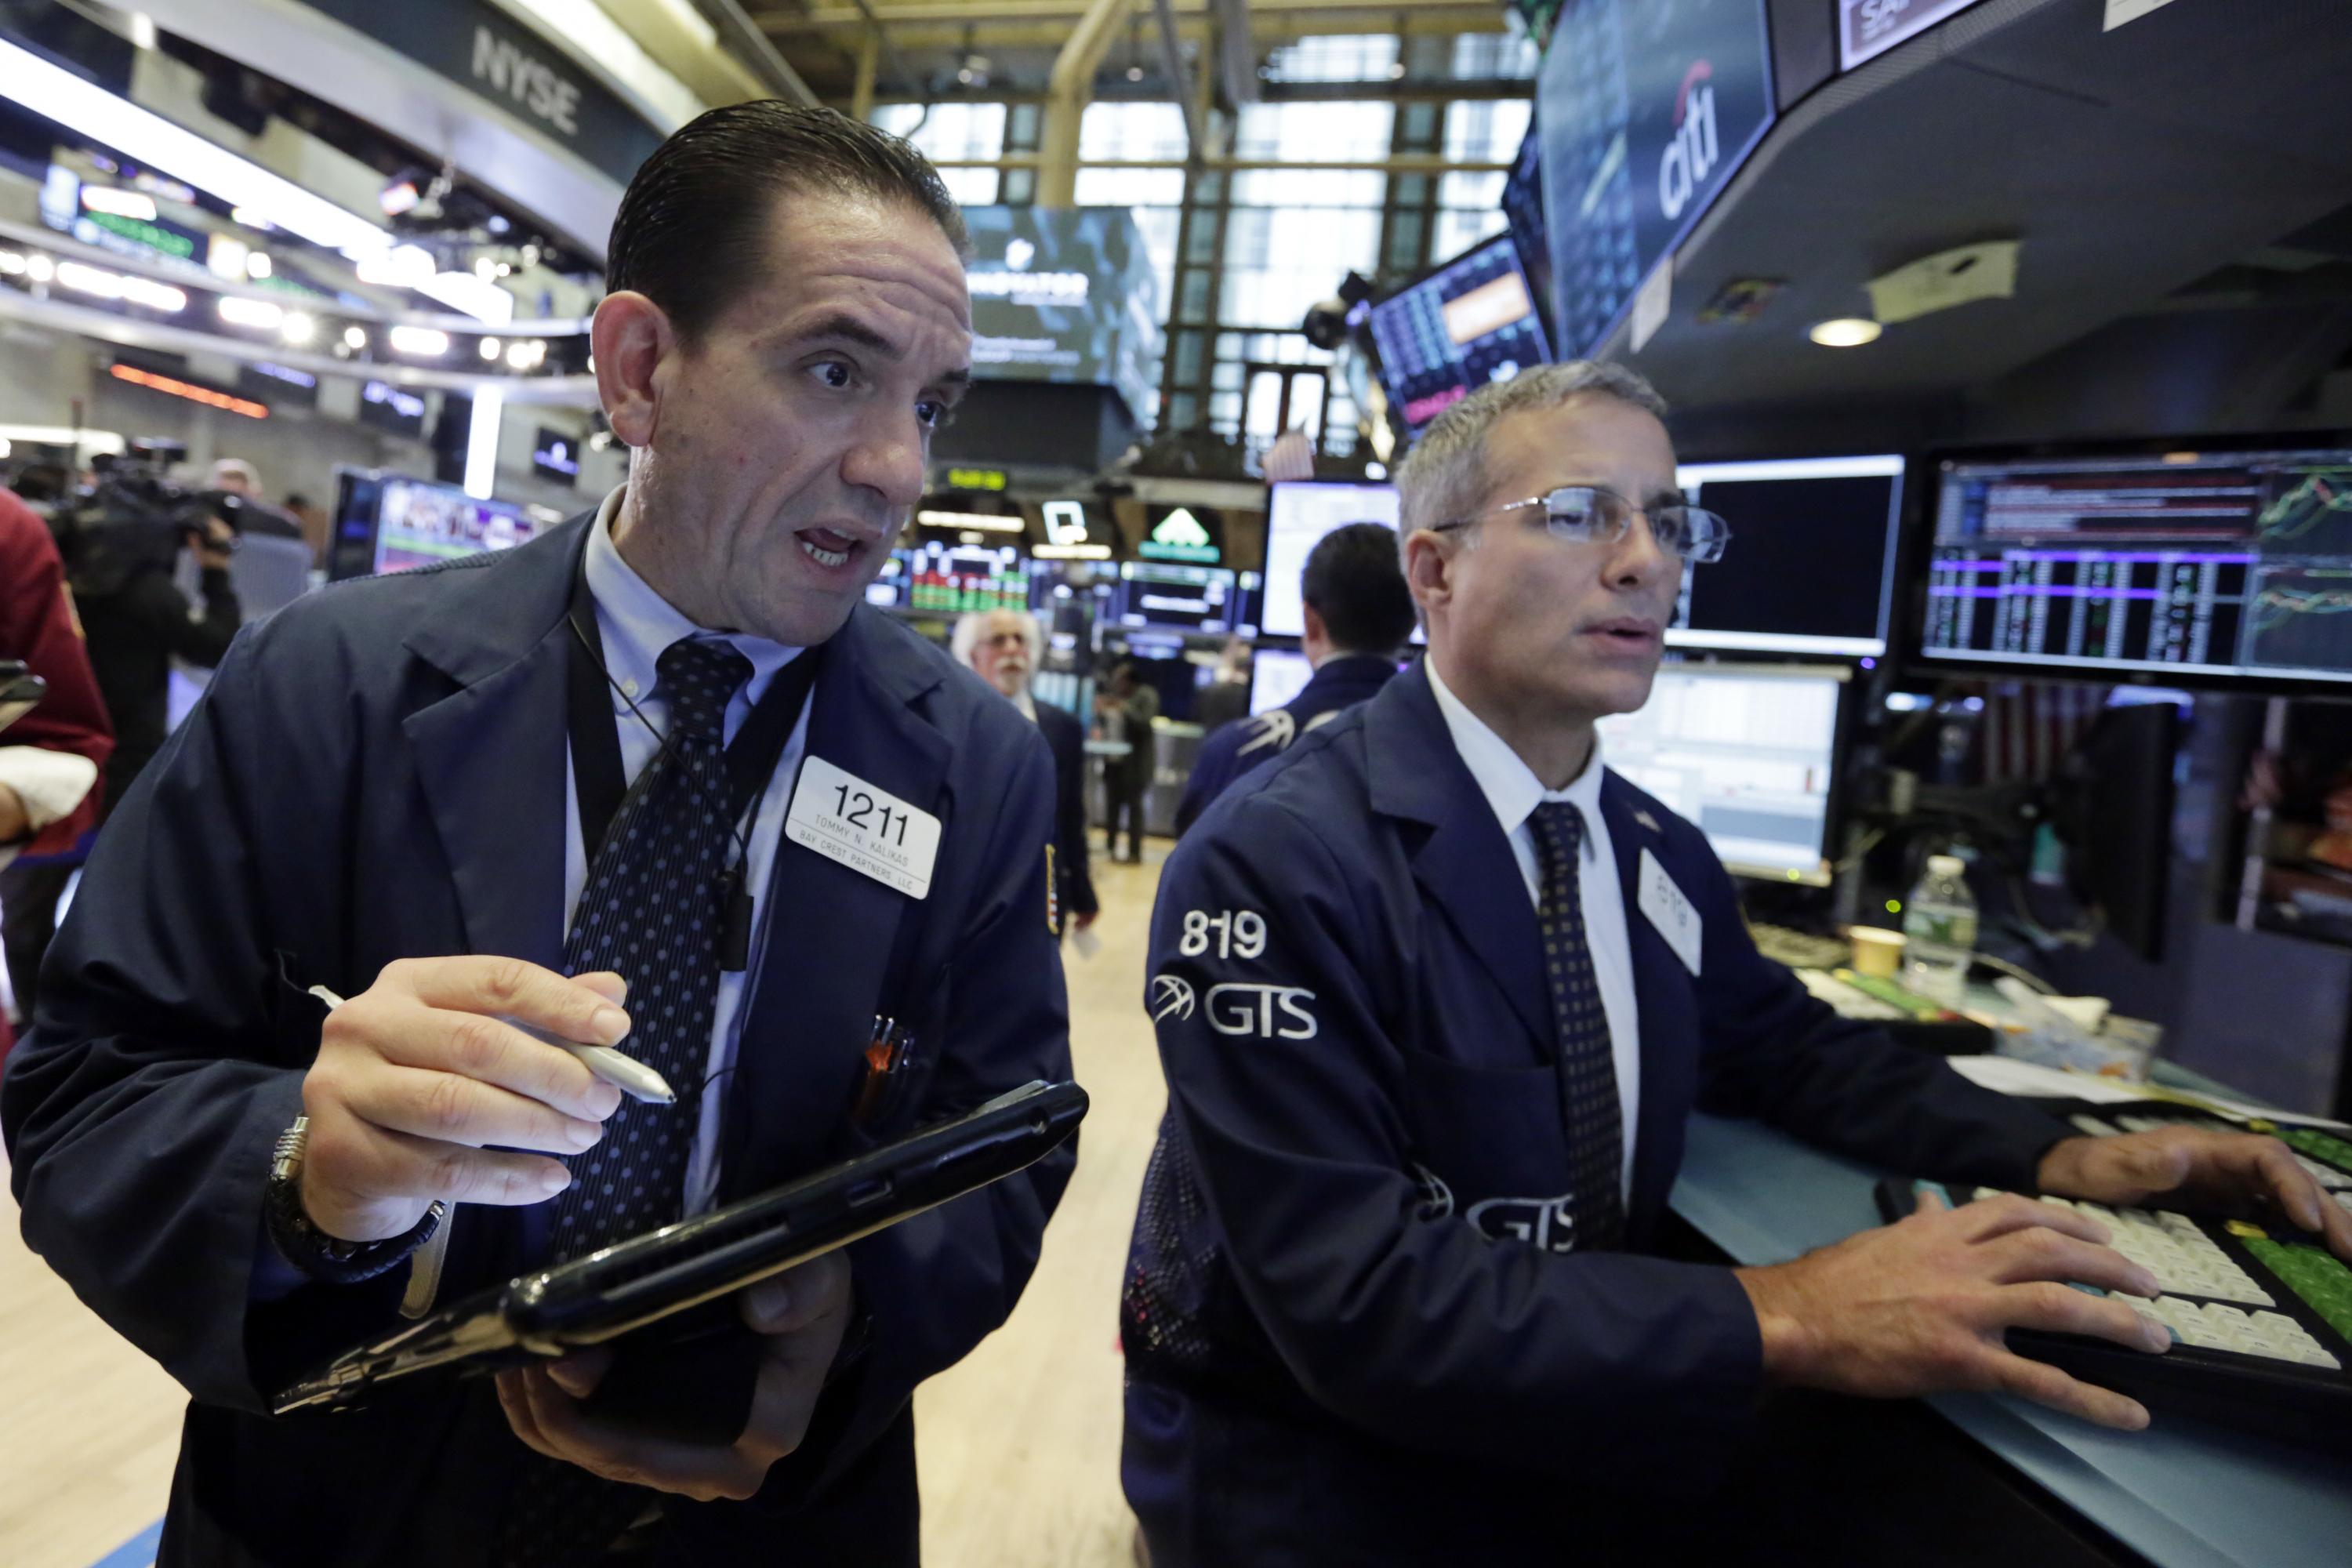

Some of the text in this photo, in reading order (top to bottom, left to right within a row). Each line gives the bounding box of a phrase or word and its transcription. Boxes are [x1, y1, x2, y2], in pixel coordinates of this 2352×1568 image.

[472, 26, 582, 136] NYSE
[1659, 85, 1719, 220] citi
[815, 814, 851, 837] TOMMY
[870, 840, 909, 867] KALIKAS
[835, 785, 908, 847] 1211
[800, 829, 818, 844] BAY
[820, 840, 847, 858] CREST
[898, 877, 914, 890] LLC
[1204, 983, 1318, 1040] GTS
[1466, 1192, 1573, 1252] GTS
